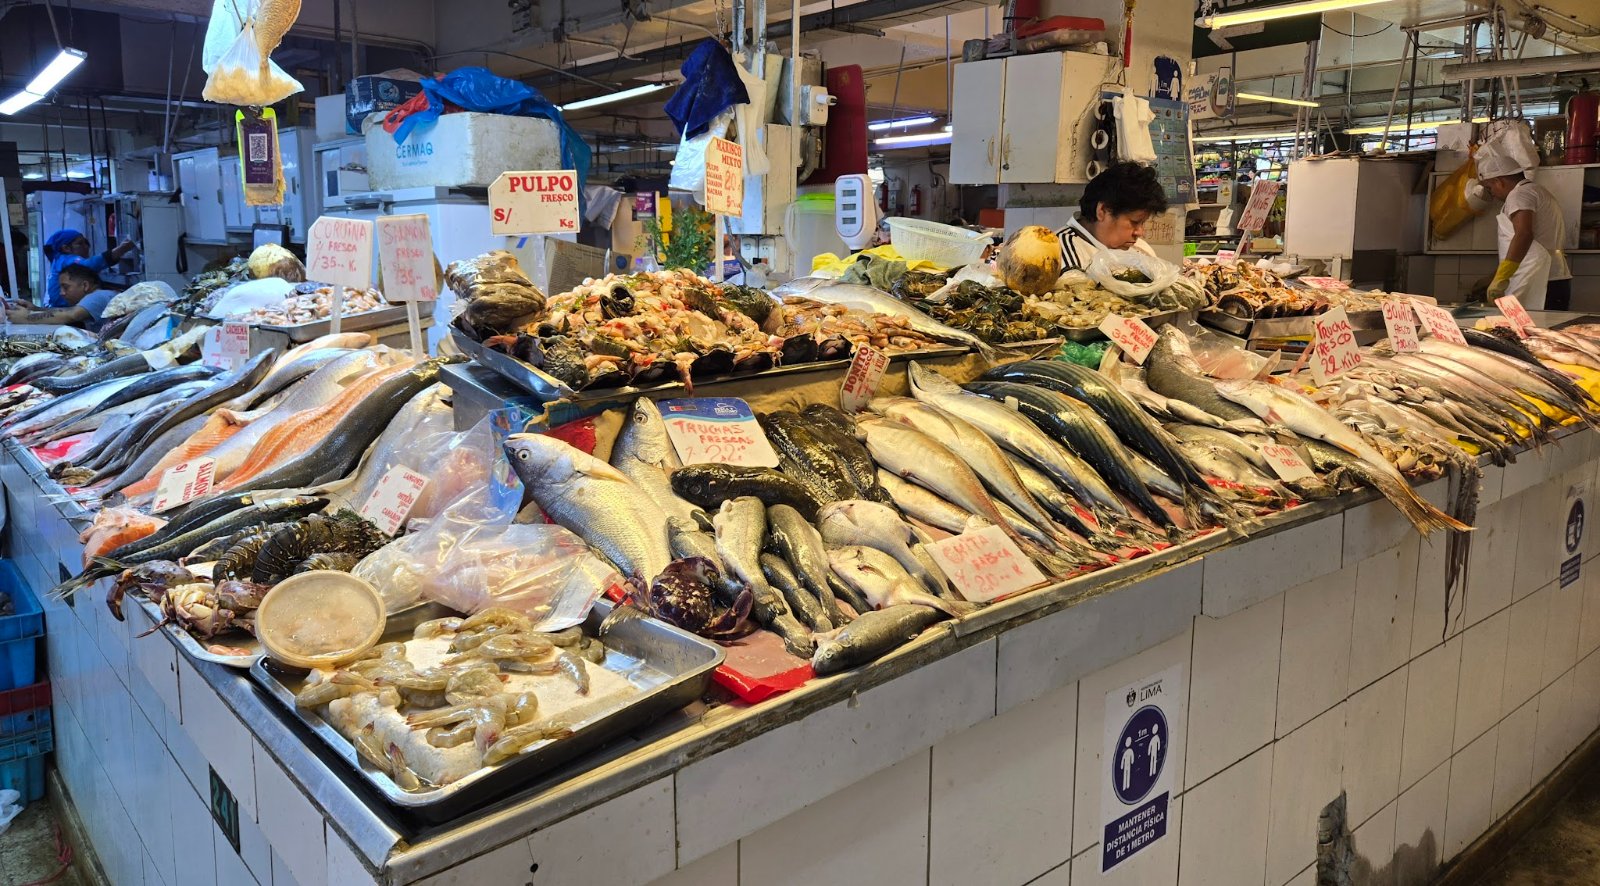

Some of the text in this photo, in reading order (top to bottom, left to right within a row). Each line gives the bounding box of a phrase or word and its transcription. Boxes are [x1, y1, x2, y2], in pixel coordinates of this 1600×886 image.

[396, 142, 434, 159] CERMAQ
[721, 154, 742, 168] MIXTO
[508, 175, 573, 192] PULPO
[541, 194, 574, 202] FRESCO
[494, 208, 574, 228] S/ Kg
[843, 346, 869, 394] BONITO
[858, 350, 874, 383] FRESCO
[192, 461, 213, 498] SALMON
[1140, 685, 1162, 702] LIMA
[1118, 805, 1156, 834] MANTENER
[1106, 824, 1142, 852] DISTANCIA
[1115, 845, 1126, 859] DE
[1131, 828, 1155, 850] METRO
